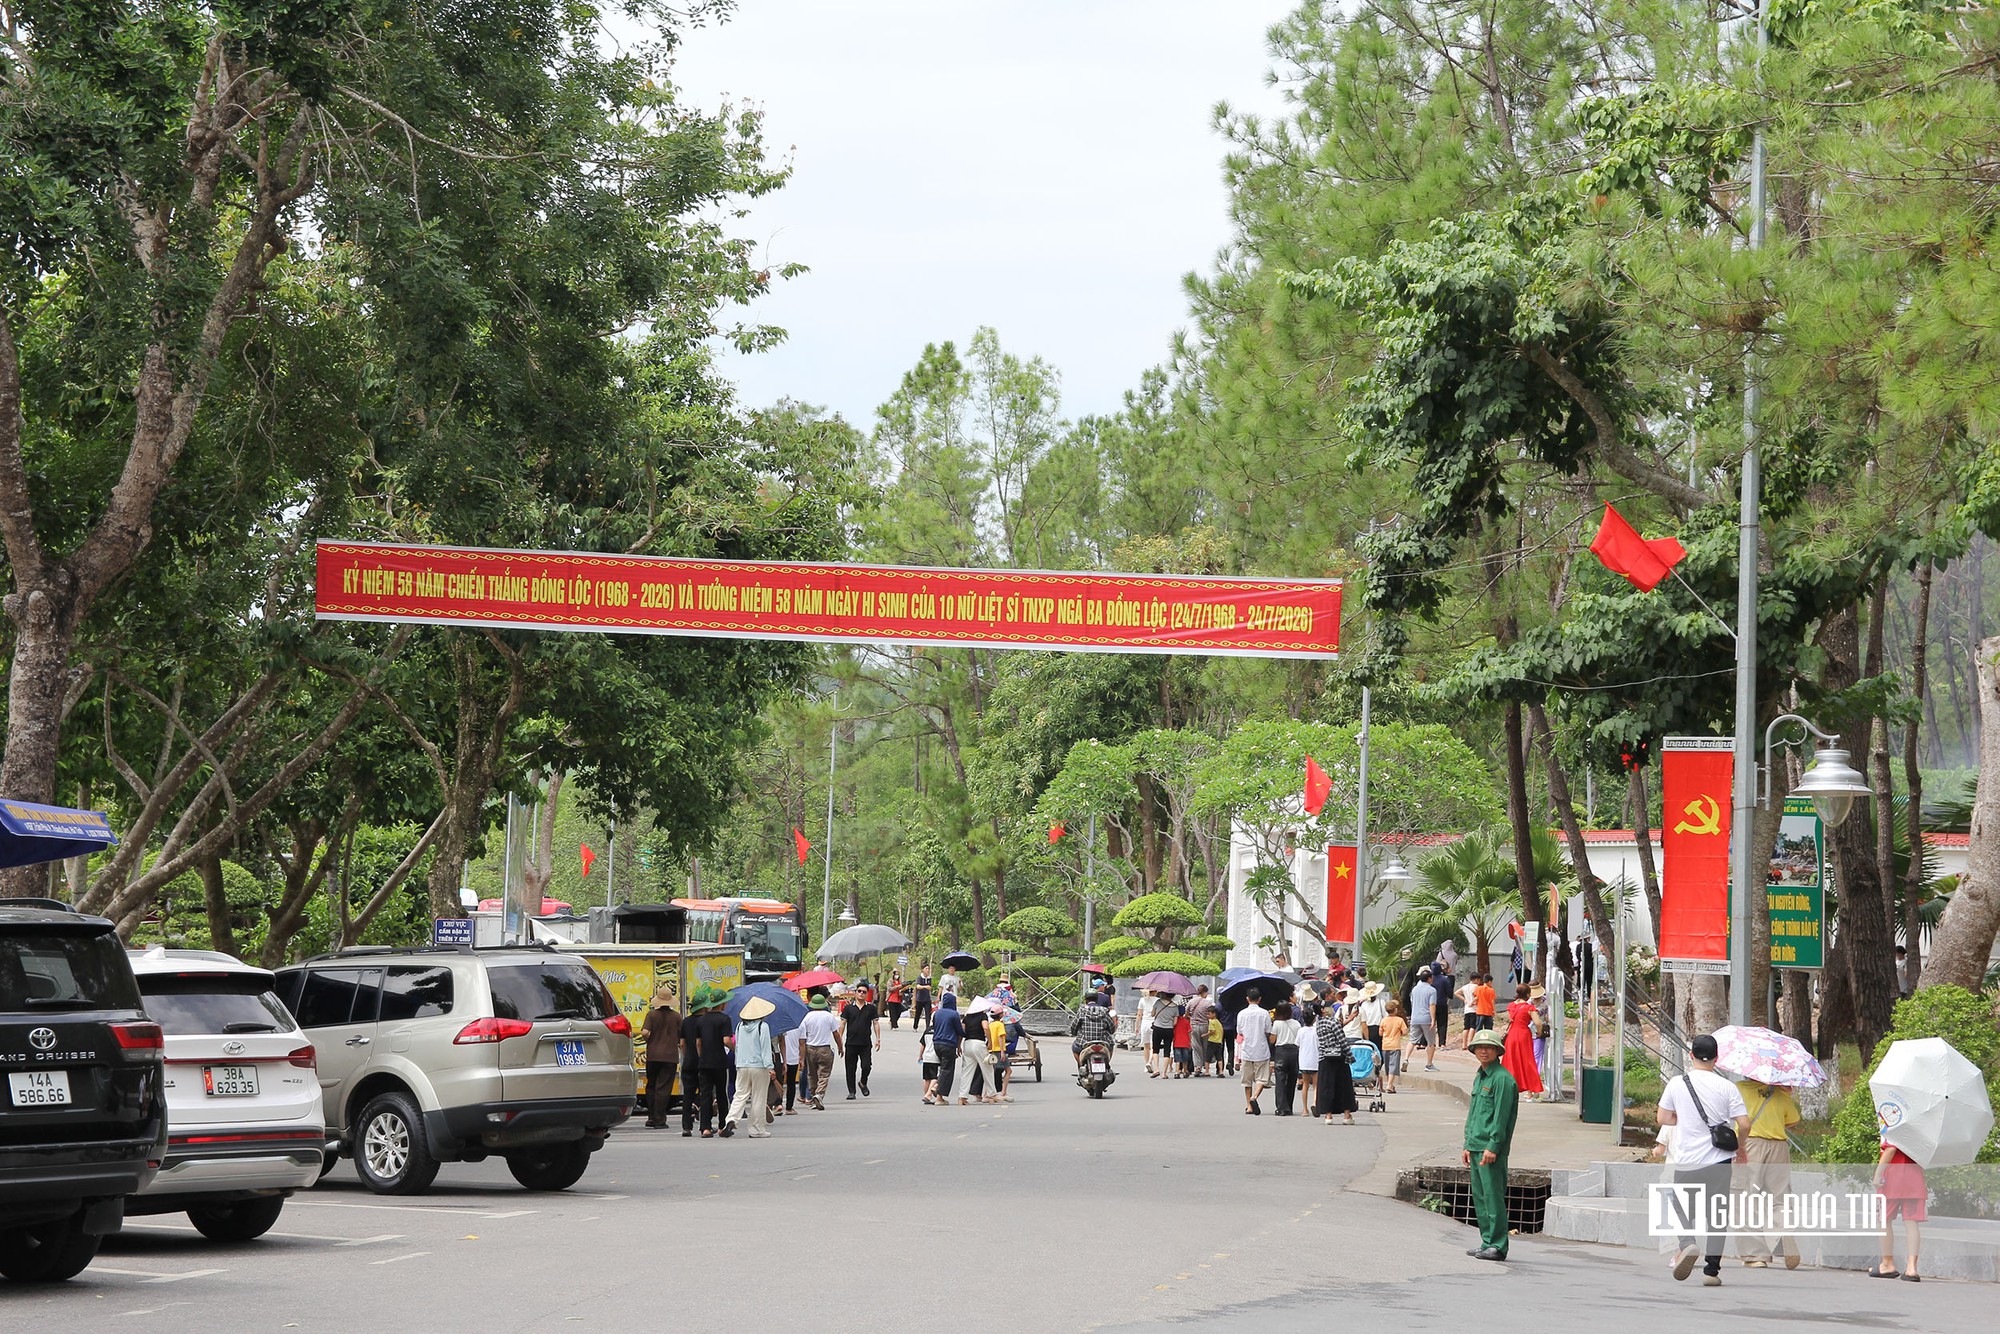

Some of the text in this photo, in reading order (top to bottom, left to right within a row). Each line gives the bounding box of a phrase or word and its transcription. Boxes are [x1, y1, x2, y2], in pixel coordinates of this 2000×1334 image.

[343, 561, 359, 594] KỶ
[362, 568, 394, 601] NIỆM
[397, 572, 412, 596] 58
[415, 568, 445, 598] NĂM
[447, 566, 485, 599] CHIẾN
[488, 567, 528, 602] THẮNG
[531, 570, 565, 603] ĐỒNG
[567, 574, 591, 610] LỘC
[594, 581, 629, 608] (1968
[640, 583, 675, 611] 2026)
[678, 579, 694, 609] VÀ
[697, 577, 737, 611] TƯỞNG
[740, 582, 772, 618] NIỆM
[775, 589, 791, 613] 58
[793, 584, 823, 615] NĂM
[826, 586, 860, 616] NGÀY
[862, 591, 875, 617] HI
[877, 592, 907, 618] SINH
[910, 585, 935, 619] CỦA
[939, 595, 954, 620] 10
[956, 591, 976, 621] NỮ
[977, 591, 1004, 627] LIỆT
[1005, 592, 1020, 621] SĨ
[1022, 598, 1054, 623] TNXP
[1057, 594, 1083, 624] NGÃ
[1086, 599, 1103, 626] BA
[1105, 592, 1141, 627] ĐỒNG
[1143, 596, 1167, 632] LỘC
[1170, 602, 1236, 631] (24/7/1968
[1246, 605, 1313, 634] 24/7/2026)
[1812, 919, 1819, 940] VỆ
[601, 970, 627, 984] Nhà
[562, 1041, 578, 1053] 37A
[0, 1051, 96, 1061] AND CRUISER
[559, 1053, 586, 1066] 198.99
[29, 1073, 52, 1087] 14A
[224, 1068, 244, 1080] 38A
[217, 1081, 254, 1094] 629.35
[19, 1088, 65, 1103] 586.66
